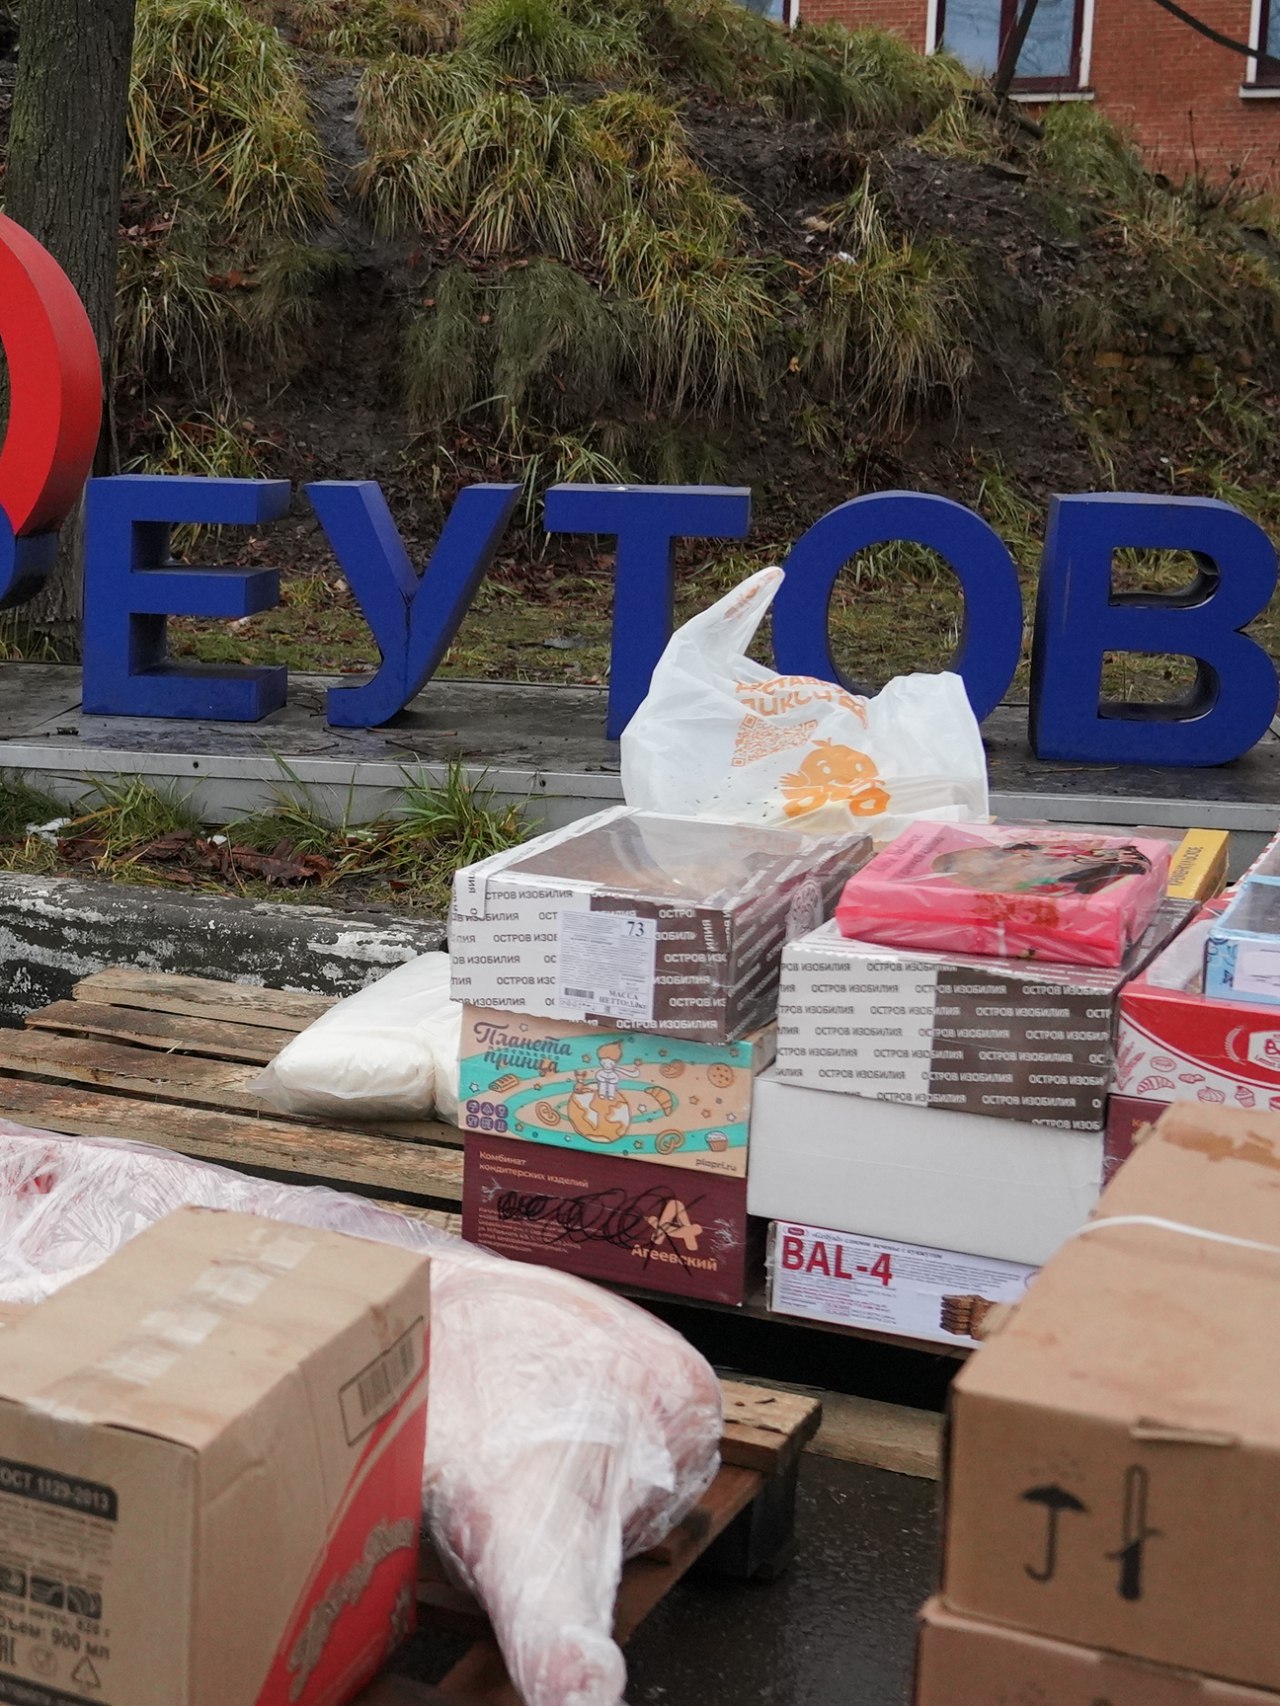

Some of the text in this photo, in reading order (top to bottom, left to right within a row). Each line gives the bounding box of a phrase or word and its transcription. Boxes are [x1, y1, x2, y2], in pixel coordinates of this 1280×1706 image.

[519, 889, 573, 899] ИЗОБИЛИЯ
[626, 920, 645, 937] 73
[493, 934, 532, 943] ОСТРОВ
[467, 955, 520, 965] ИЗОБИЛИЯ
[664, 953, 706, 963] ОСТРОВ
[801, 962, 851, 972] ИЗОБИЛИЯ
[866, 962, 903, 972] ОСТРОВ
[496, 976, 535, 985] ОСТРОВ
[811, 984, 899, 993] ОСТРОВ ИЗОБИЛИЯ
[914, 984, 1007, 995] ОСТРОВ ИЗОБИЛИЯ
[1022, 986, 1062, 995] ОСТРОВ
[473, 997, 526, 1006] ИЗОБИЛИЯ
[669, 997, 710, 1007] ОСТРОВ
[805, 1006, 854, 1015] ИЗОБИЛИЯ
[870, 1006, 960, 1015] ОСТРОВ ИЗОБИЛИЯ
[976, 1007, 1070, 1018] ОСТРОВ ИЗОБИЛИЯ
[616, 1019, 718, 1029] ОСТРОВ ИЗОБИЛИЯ
[815, 1027, 903, 1036] ОСТРОВ ИЗОБИЛИЯ
[918, 1028, 1010, 1039] ОСТРОВ ИЗОБИЛИЯ
[1025, 1030, 1064, 1040] ОСТРОВ
[474, 1021, 573, 1057] Планета
[808, 1048, 858, 1057] ИЗОБИЛИЯ
[874, 1049, 964, 1059] ОСТРОВ ИЗОБИЛИЯ
[979, 1051, 1073, 1062] ОСТРОВ ИЗОБИЛИЯ
[484, 1050, 559, 1078] принца
[818, 1069, 906, 1079] ОСТРОВ ИЗОБИЛИЯ
[921, 1071, 1013, 1083] ОСТРОВ ИЗОБИЛИЯ
[1028, 1074, 1068, 1084] ОСТРОВ
[877, 1092, 967, 1103] ОСТРОВ ИЗОБИЛИЯ
[982, 1095, 1076, 1107] ОСТРОВ ИЗОБИЛИЯ
[479, 1150, 528, 1167] Комбинат
[479, 1163, 590, 1189] кондитерских изделий
[632, 1243, 718, 1272] Агеевский
[782, 1235, 893, 1287] BAL-4
[52, 1628, 80, 1651] 900
